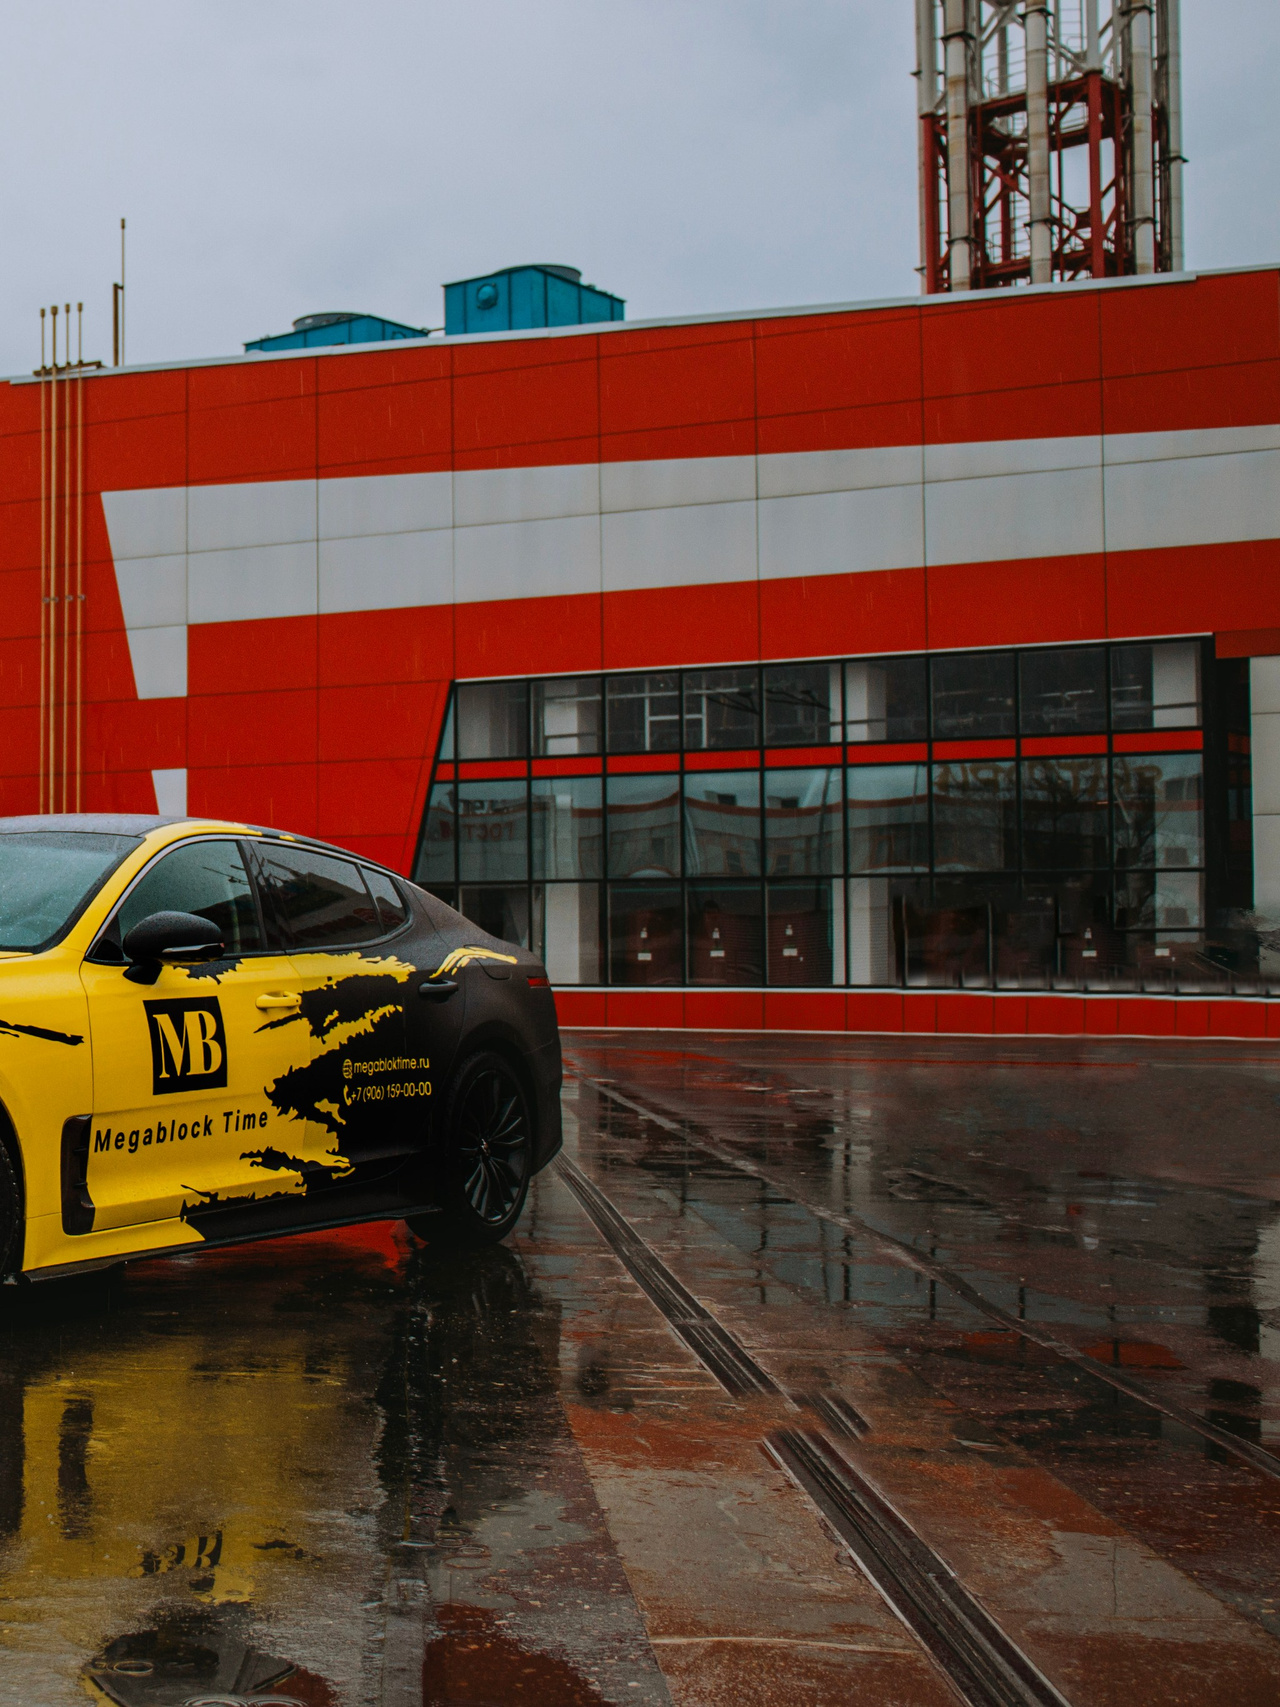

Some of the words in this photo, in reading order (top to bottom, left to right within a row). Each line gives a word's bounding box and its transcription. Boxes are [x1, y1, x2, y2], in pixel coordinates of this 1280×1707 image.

[152, 1010, 223, 1079] MB
[353, 1057, 430, 1077] megabloktime.ru
[351, 1087, 362, 1101] +7
[362, 1085, 385, 1103] (906)
[386, 1081, 432, 1099] 159-00-00
[94, 1114, 213, 1154] Megablock
[223, 1109, 268, 1134] Time
